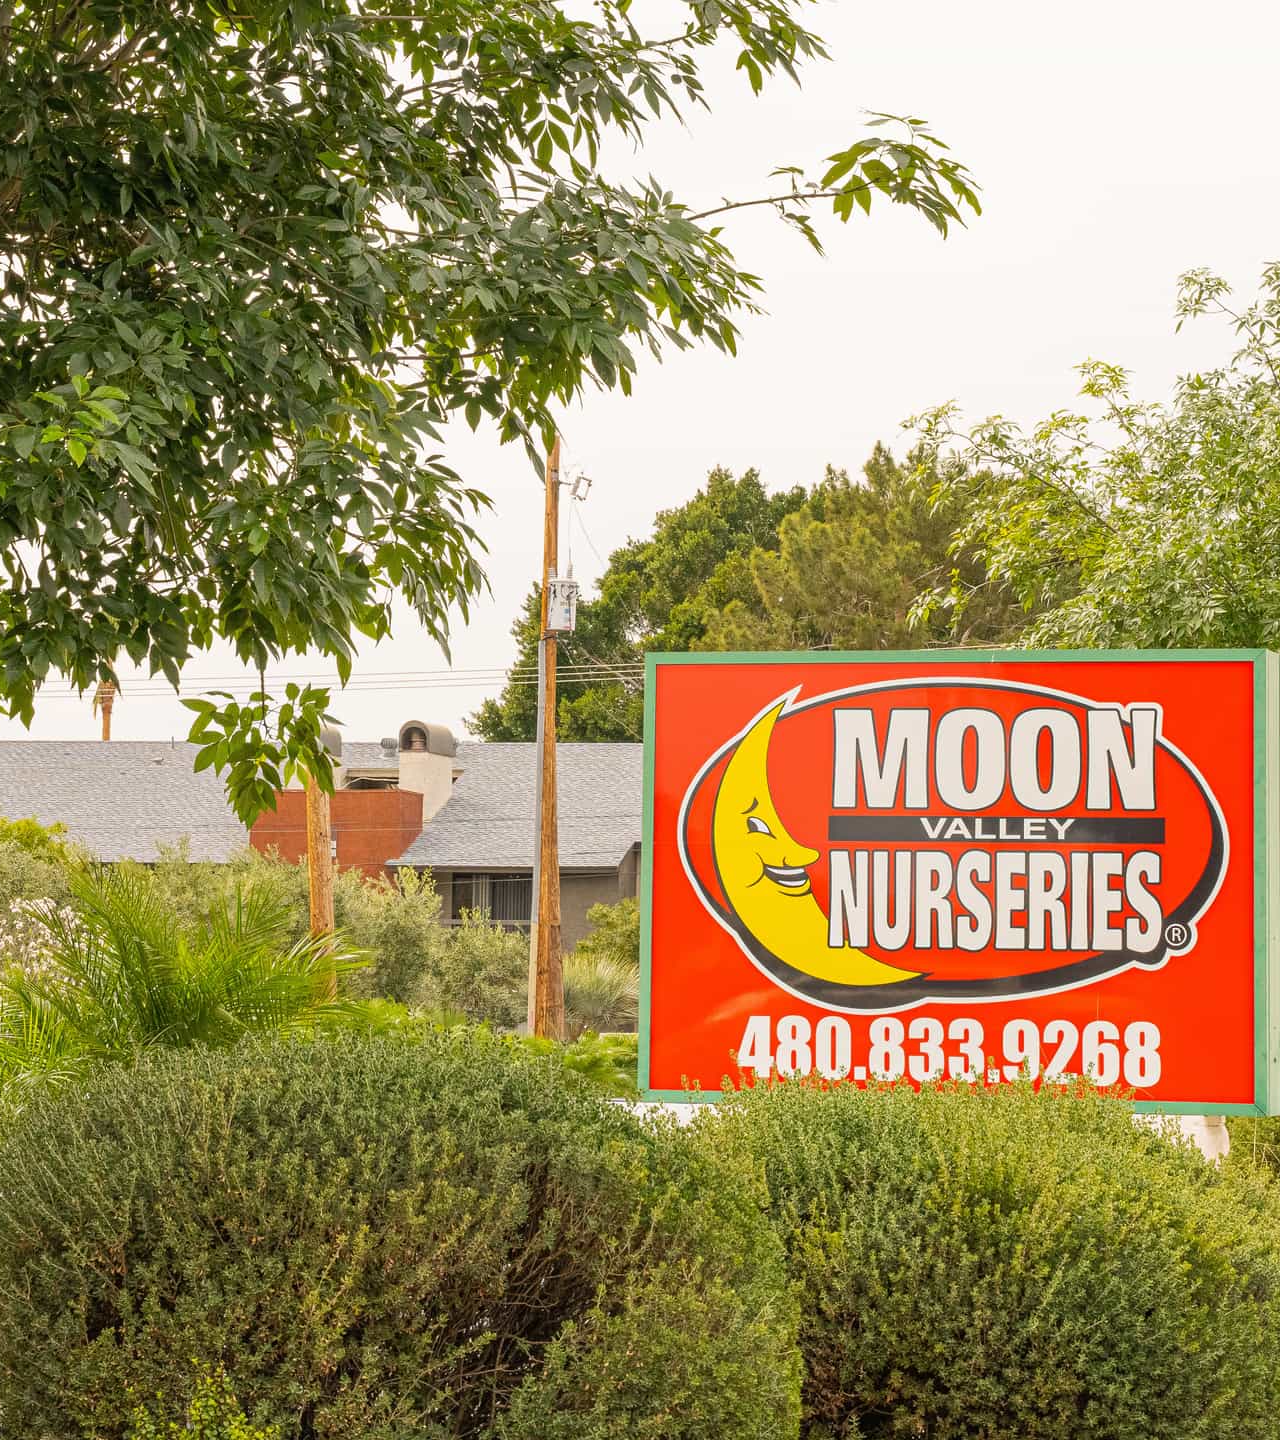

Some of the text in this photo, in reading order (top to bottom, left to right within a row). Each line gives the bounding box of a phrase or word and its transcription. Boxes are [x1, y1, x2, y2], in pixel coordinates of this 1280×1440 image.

[832, 707, 1157, 811] MOON
[919, 817, 1075, 840] VALLEY
[828, 849, 1163, 953] NURSERIES
[737, 1014, 1162, 1088] 480.833.9268
